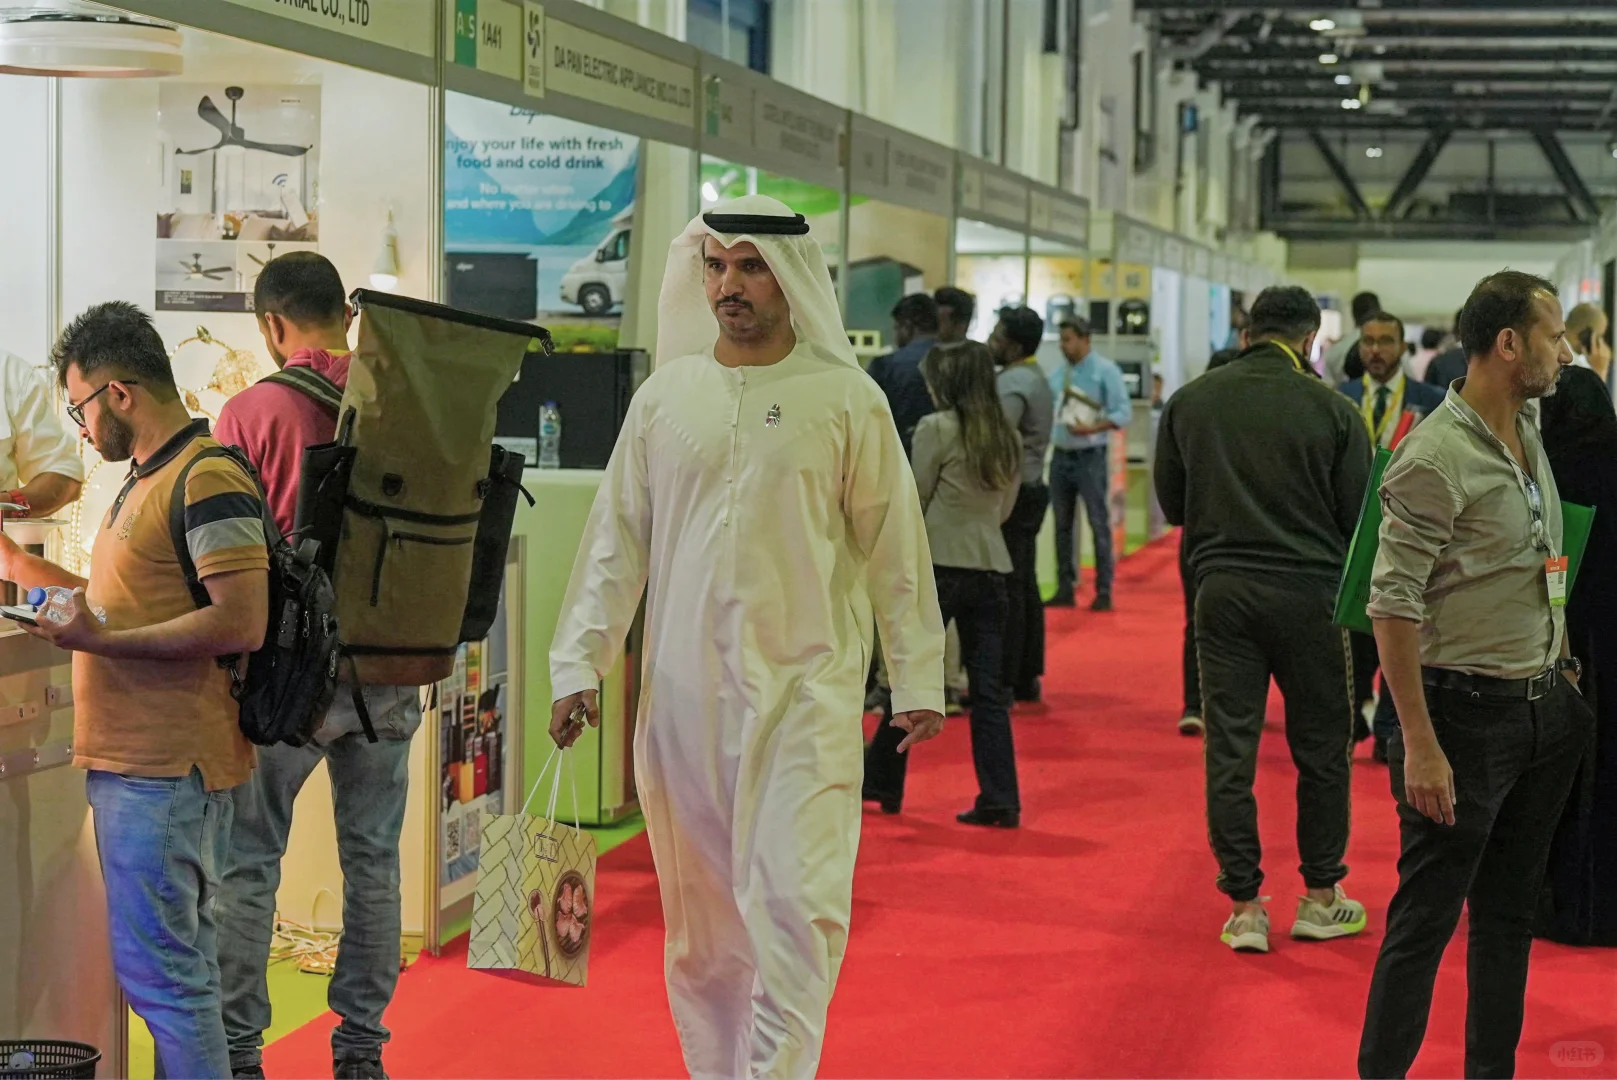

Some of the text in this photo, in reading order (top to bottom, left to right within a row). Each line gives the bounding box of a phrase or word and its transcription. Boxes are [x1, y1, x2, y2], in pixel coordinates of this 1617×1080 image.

[348, 0, 369, 26] LTD
[481, 21, 502, 50] 1A41
[583, 54, 618, 85] ELECTRIC
[445, 136, 623, 154] njoy your life with fresh
[457, 156, 604, 169] food and cold drink
[480, 183, 499, 195] No
[598, 199, 612, 209] to
